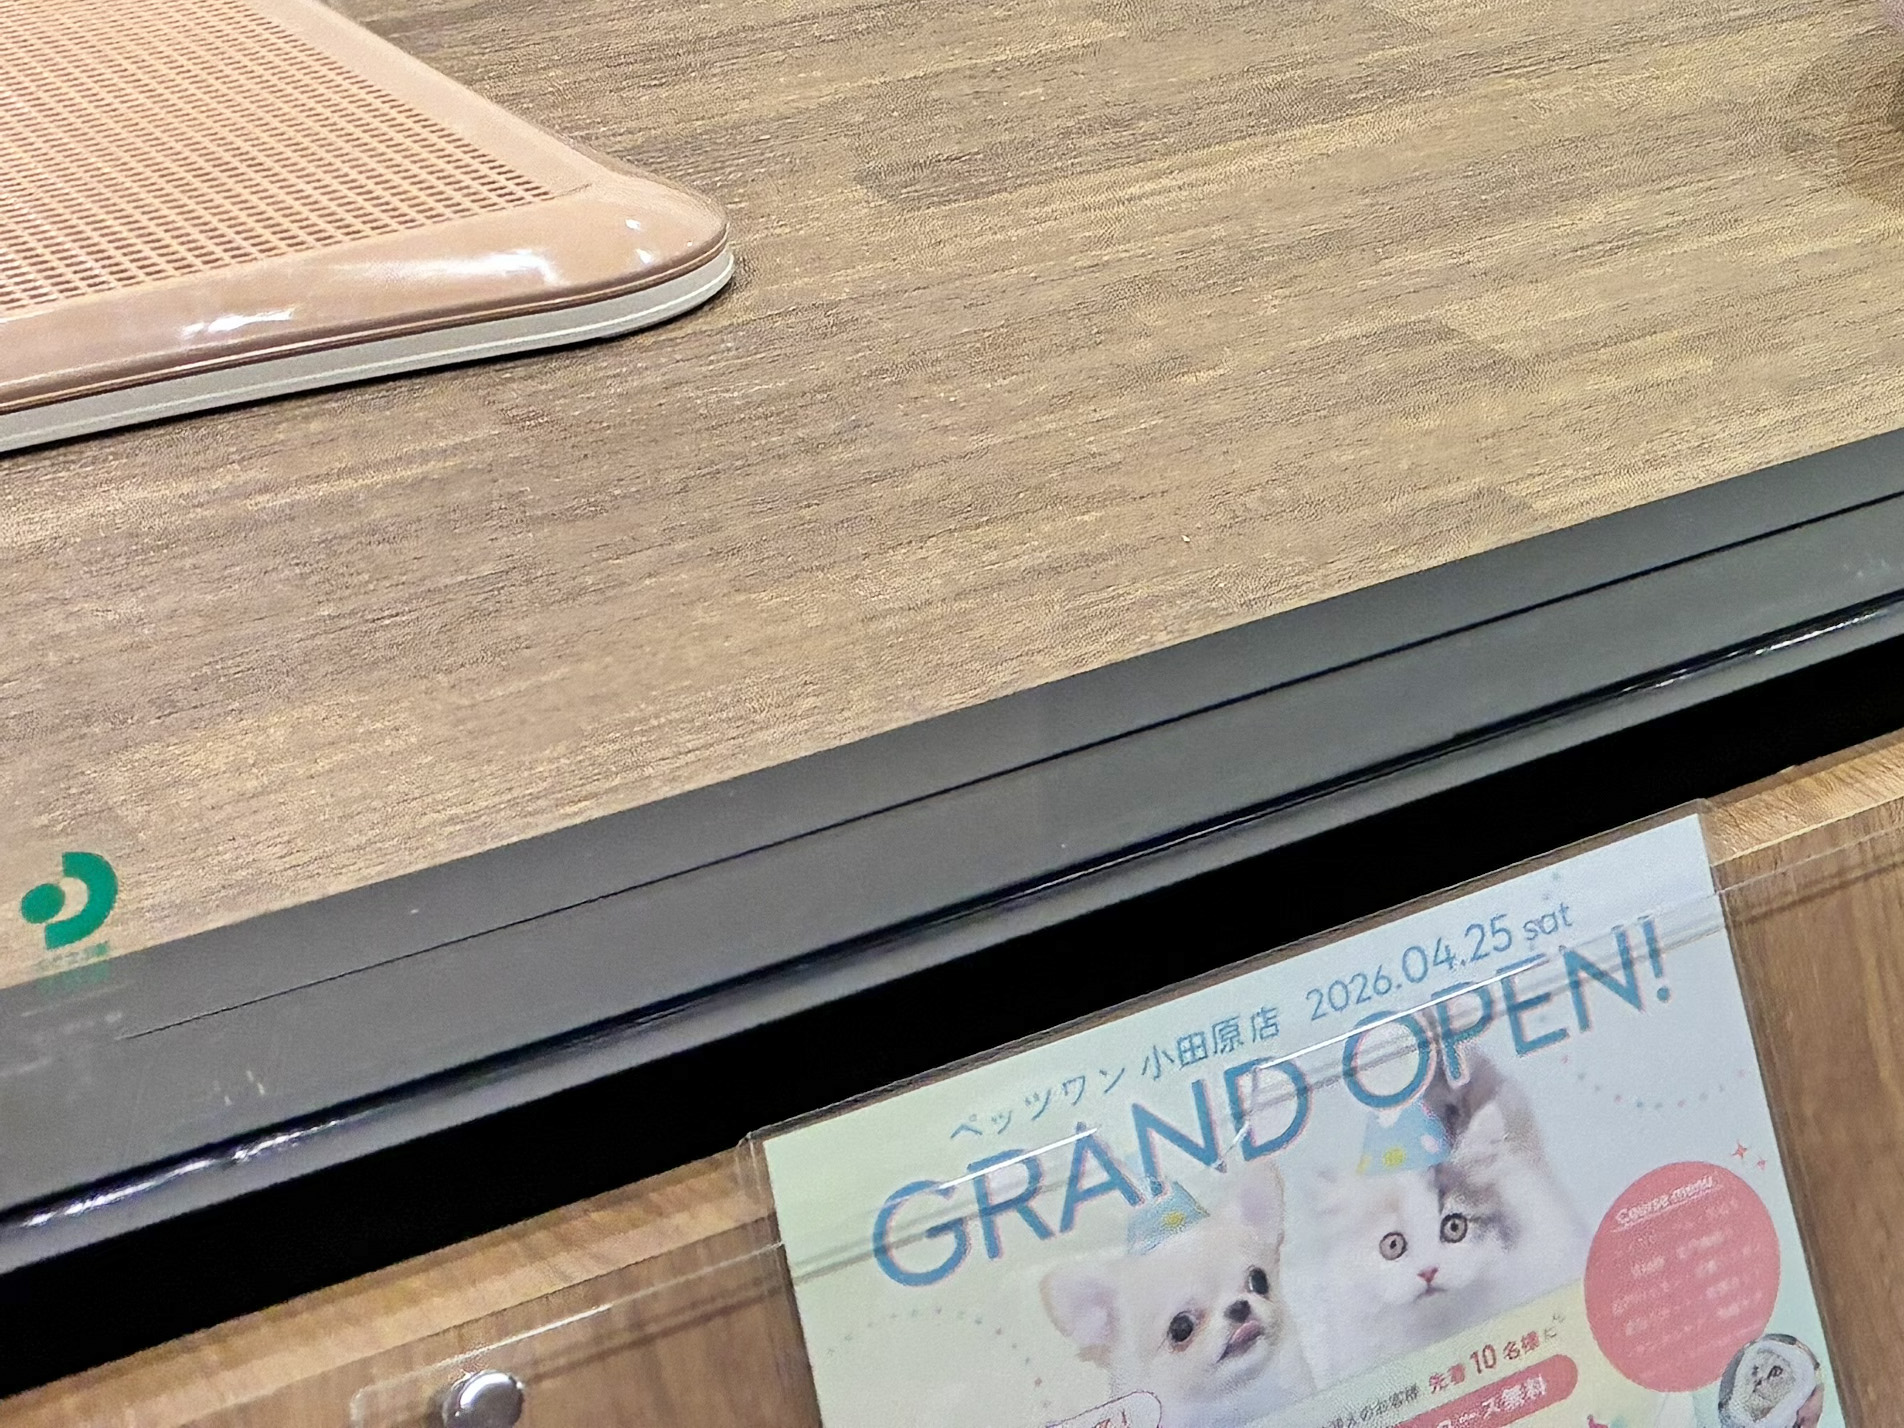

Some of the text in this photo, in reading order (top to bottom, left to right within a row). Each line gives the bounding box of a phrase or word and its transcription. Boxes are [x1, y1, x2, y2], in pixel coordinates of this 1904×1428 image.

[870, 914, 1671, 1290] GRAND OPEN!
[949, 899, 1573, 1145] ペッツワン 小田原店 2026.04.25 sat
